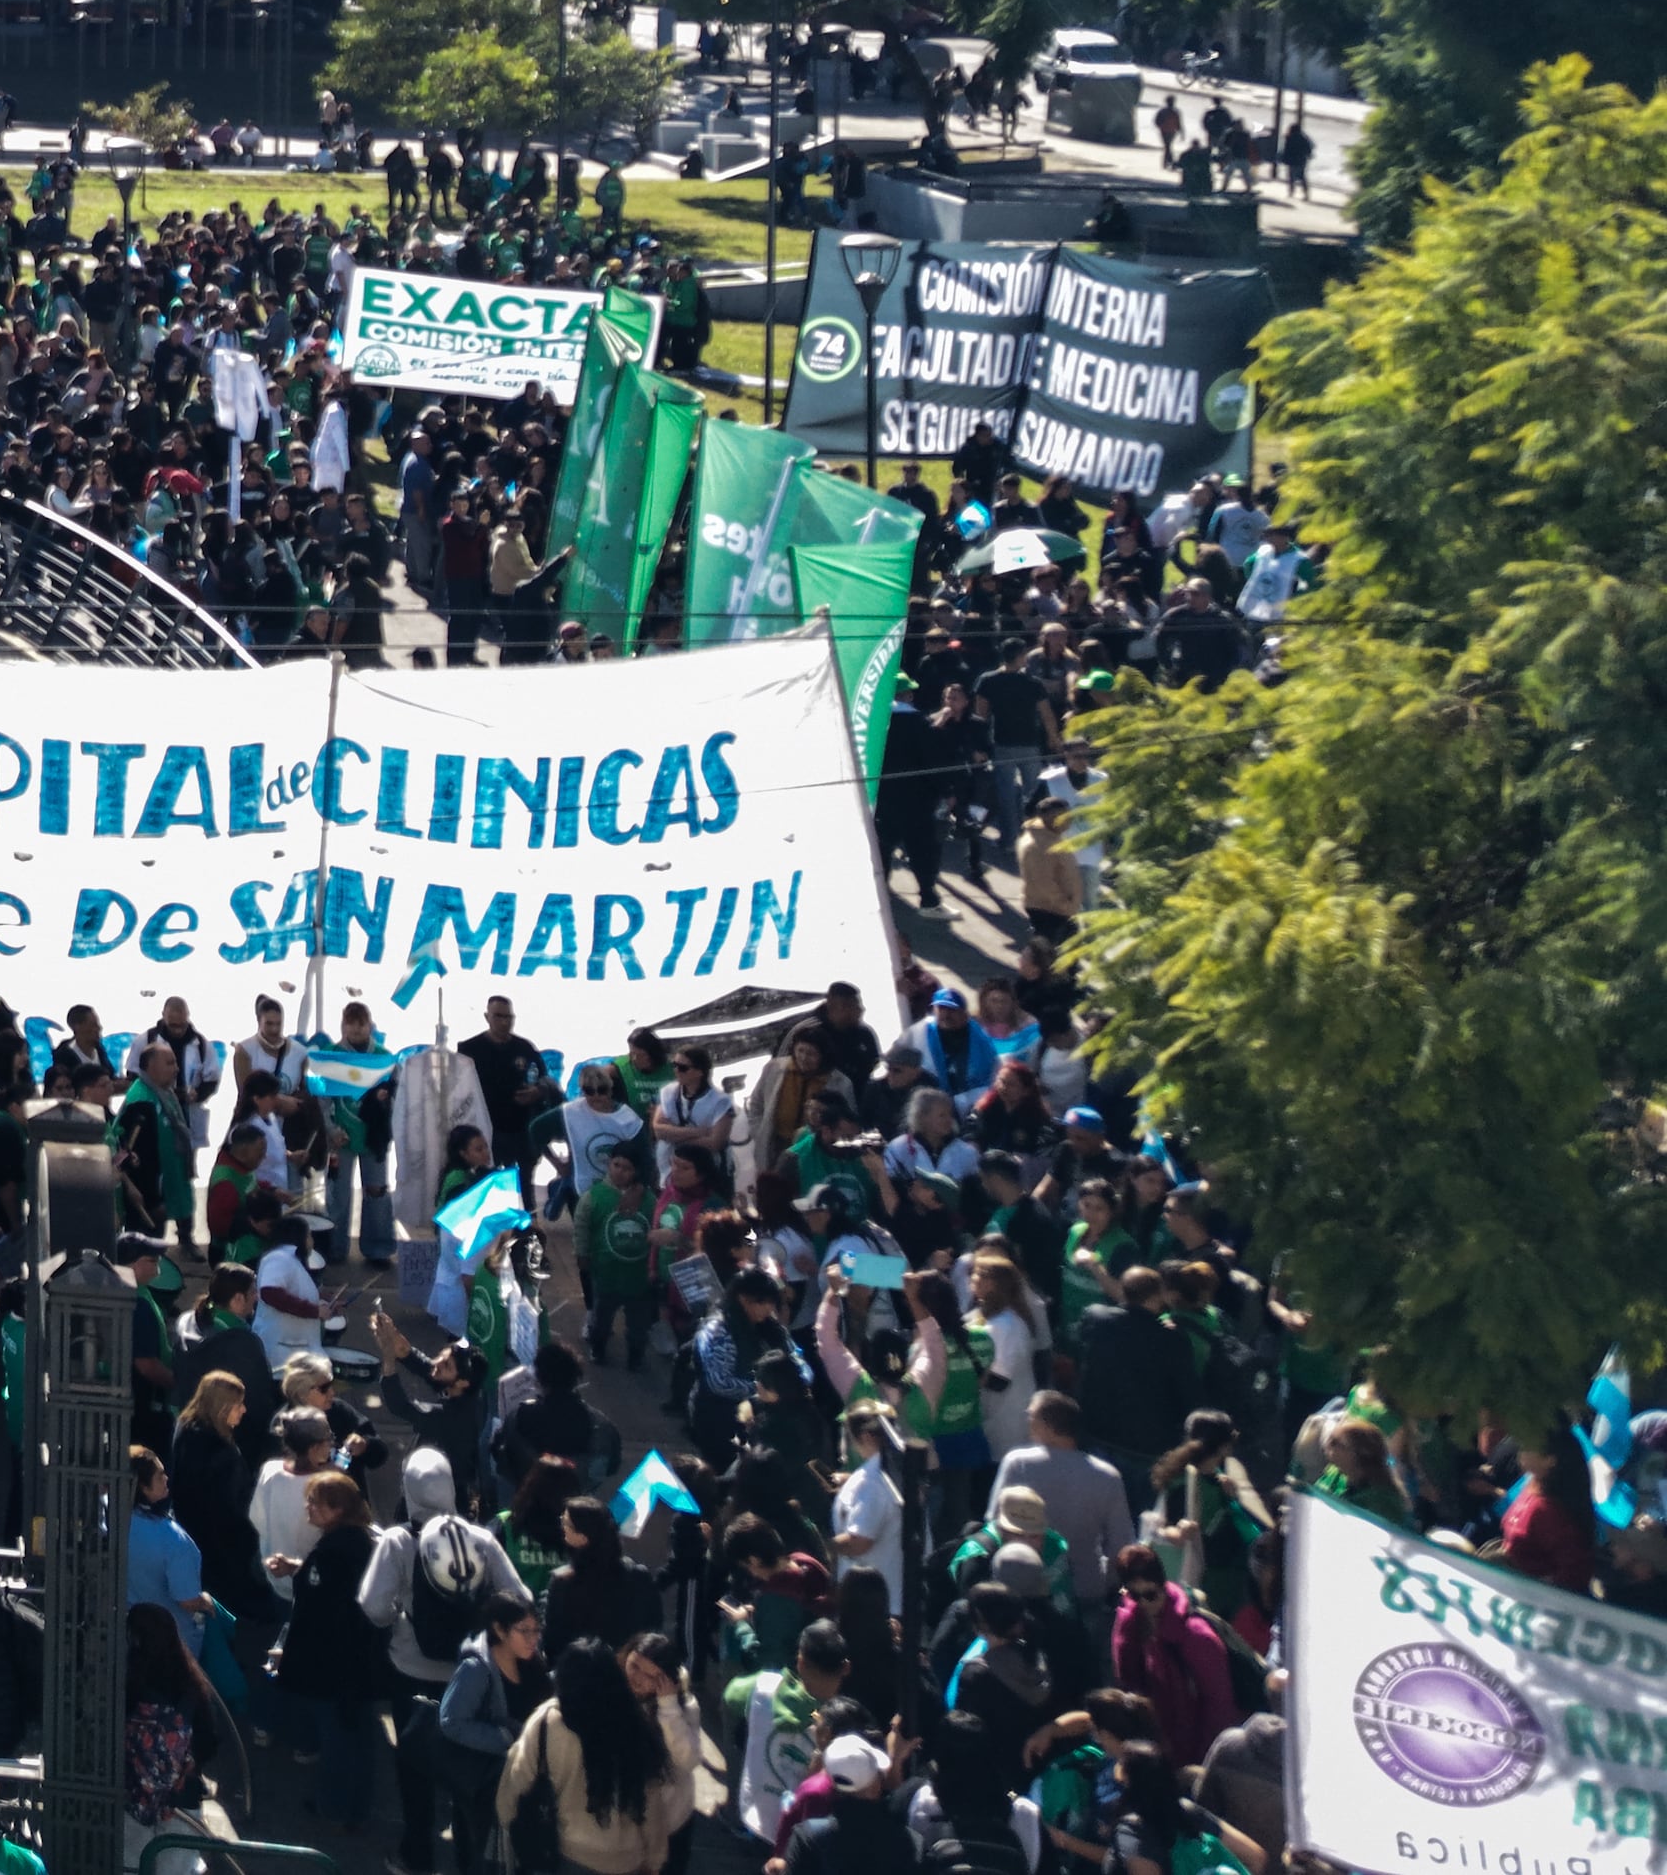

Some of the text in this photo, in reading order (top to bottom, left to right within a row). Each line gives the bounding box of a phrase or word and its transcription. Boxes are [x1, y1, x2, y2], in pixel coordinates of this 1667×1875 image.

[368, 323, 503, 355] COMISIÓN
[812, 331, 846, 356] 74
[1048, 264, 1167, 348] INTERNA
[864, 326, 1015, 389] FACULTAD
[1048, 345, 1199, 424] MEDICINA
[1015, 410, 1165, 498] SUMANDO
[266, 760, 312, 812] de
[311, 730, 741, 849] CLINICAS
[218, 865, 395, 965] SAN
[407, 869, 804, 982] MARTIN
